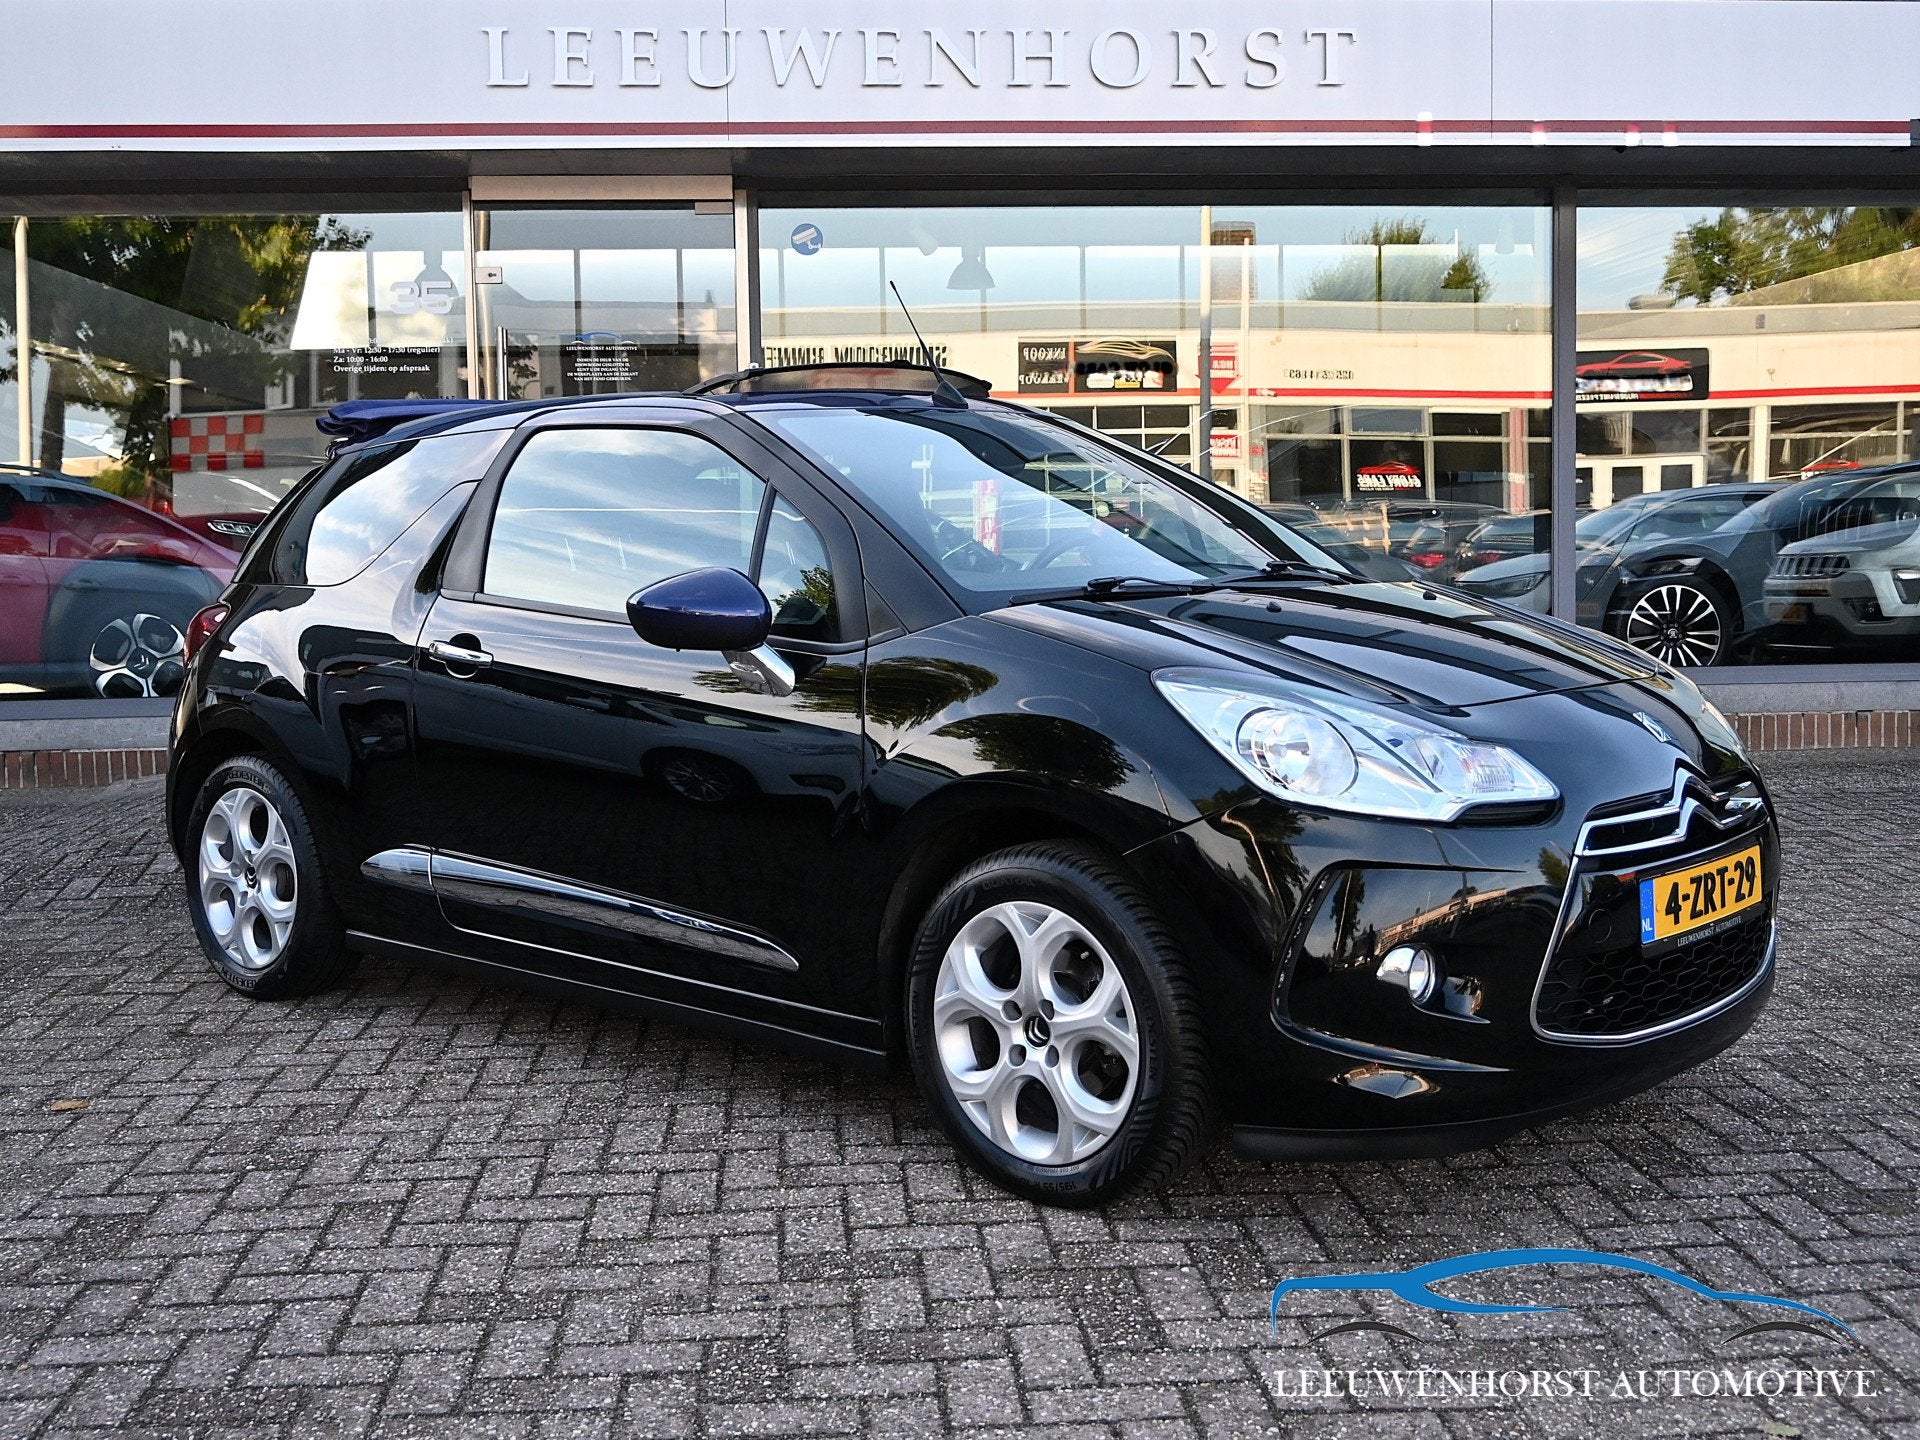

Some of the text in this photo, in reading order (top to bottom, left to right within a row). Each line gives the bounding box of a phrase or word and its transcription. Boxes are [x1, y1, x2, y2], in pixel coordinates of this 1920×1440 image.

[482, 26, 1358, 88] LEEUWENHORST
[390, 281, 452, 315] 35
[333, 365, 363, 374] Overige
[364, 365, 387, 374] tijden:
[400, 365, 430, 374] afspraak
[1665, 856, 1757, 926] 4-ZRT-29
[1642, 918, 1652, 932] NL
[1677, 916, 1742, 946] LEEUWENHORST AUTOMOTIVE
